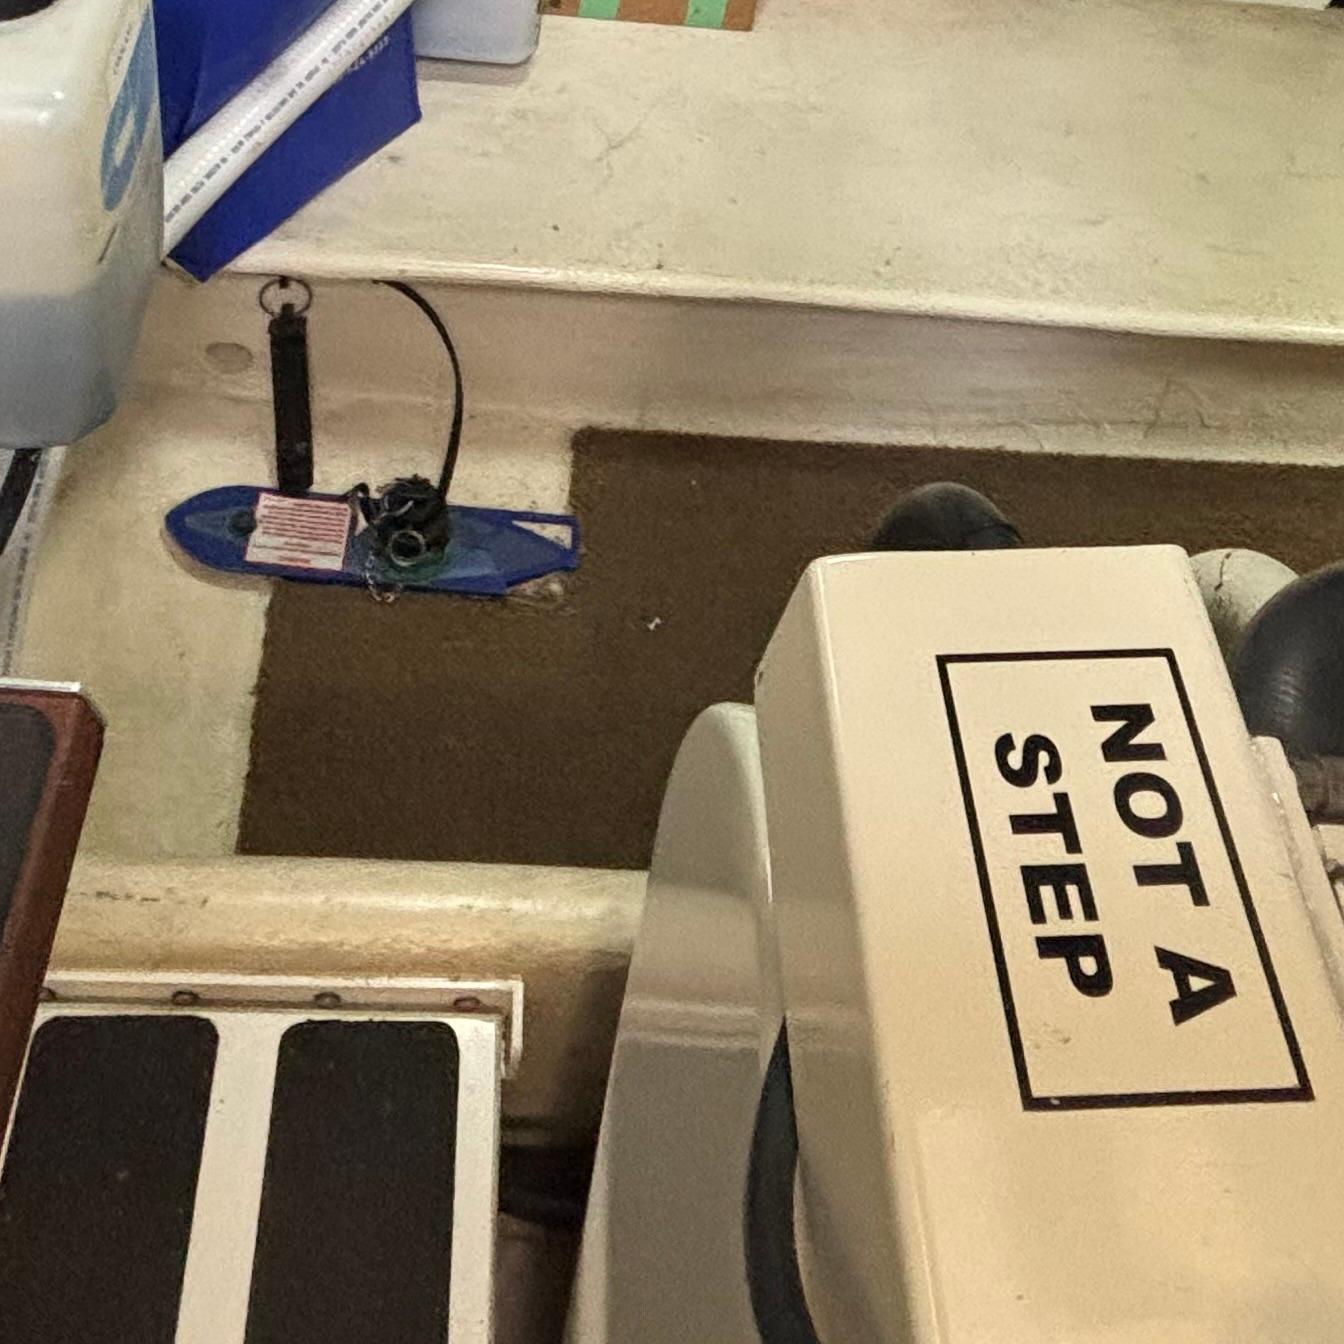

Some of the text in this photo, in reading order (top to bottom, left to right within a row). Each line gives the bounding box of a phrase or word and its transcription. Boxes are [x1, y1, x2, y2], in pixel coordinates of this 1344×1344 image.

[994, 732, 1114, 998] STEP
[1089, 703, 1238, 1027] NOT A
